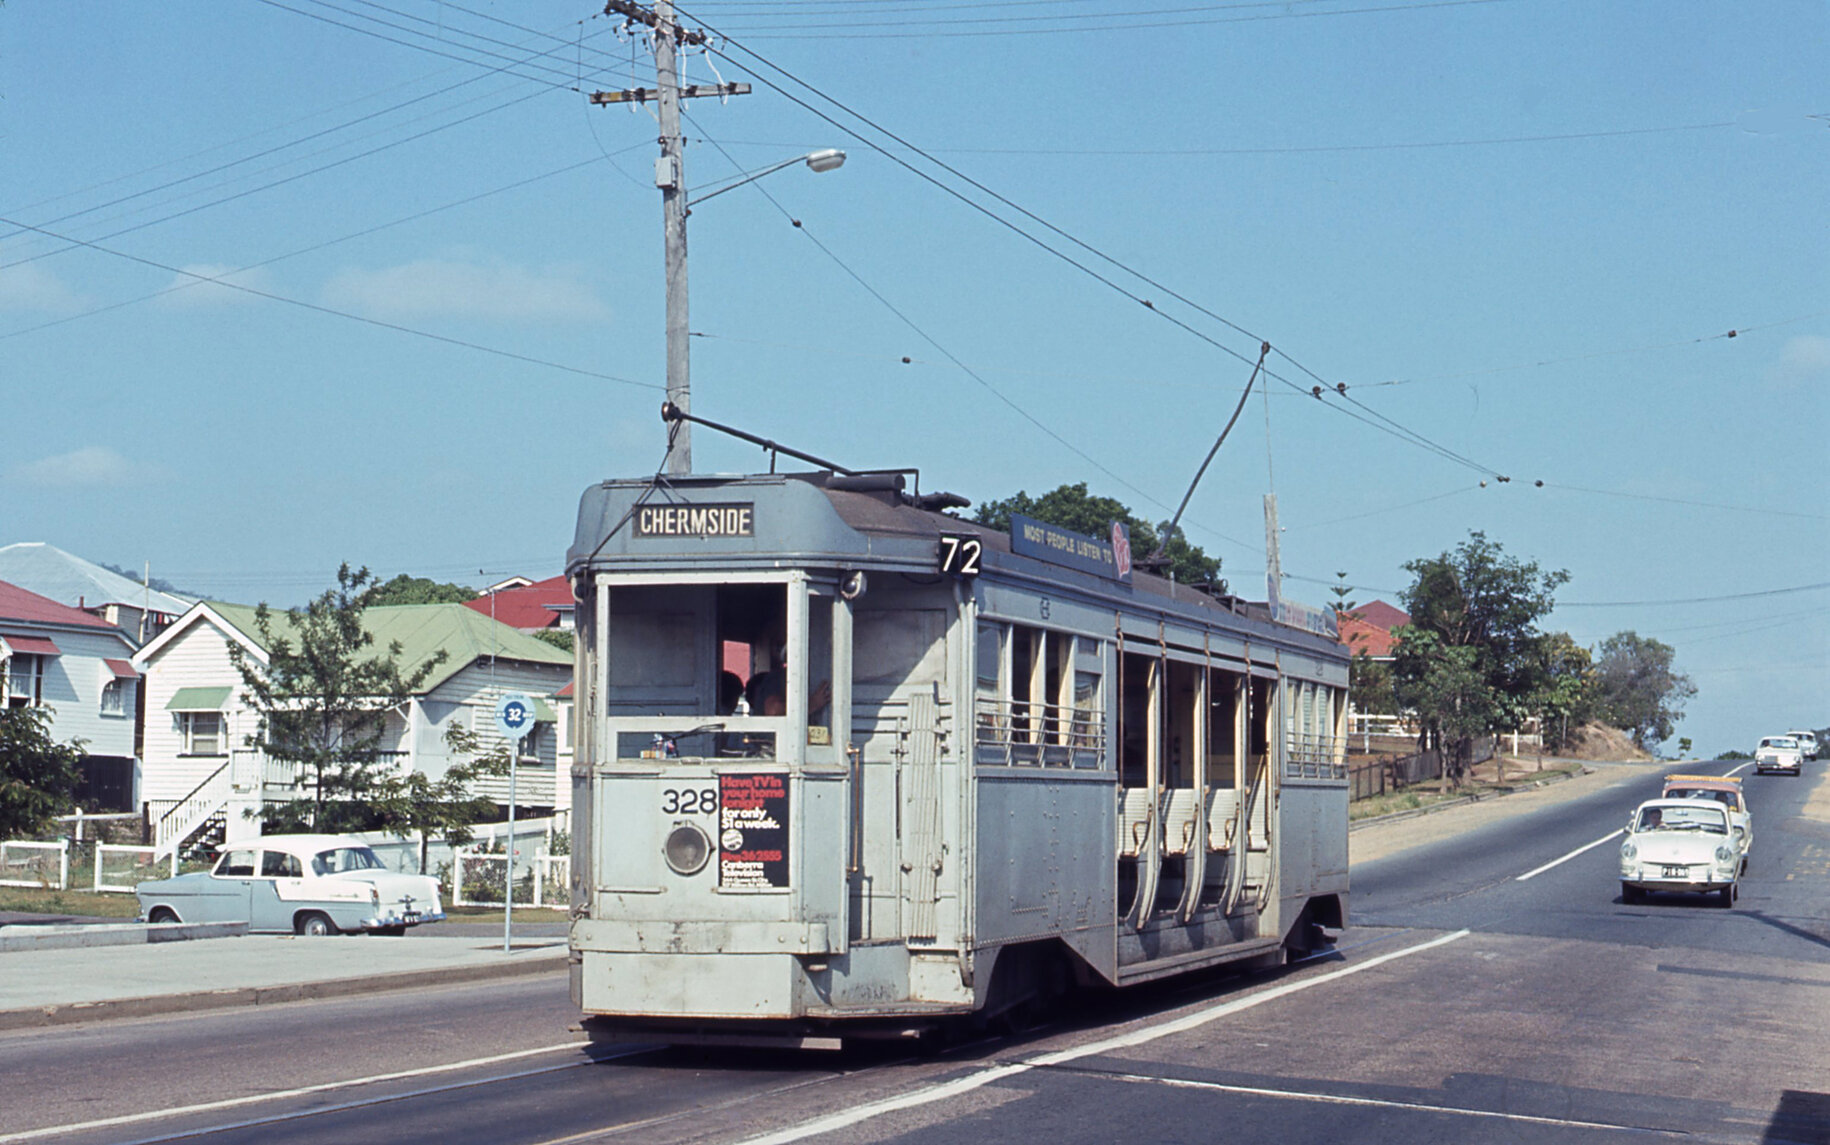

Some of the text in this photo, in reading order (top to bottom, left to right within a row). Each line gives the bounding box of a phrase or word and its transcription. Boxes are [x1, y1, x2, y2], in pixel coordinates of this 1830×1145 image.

[640, 507, 751, 535] CHERMSIDE
[1024, 524, 1112, 564] MOST PEOPLE LISTEN TO
[942, 537, 981, 574] 72
[507, 707, 522, 721] 32
[721, 776, 752, 787] Have
[752, 776, 770, 787] TV
[722, 787, 785, 800] your home
[662, 789, 717, 814] 328
[722, 806, 767, 820] for only
[735, 820, 743, 828] a
